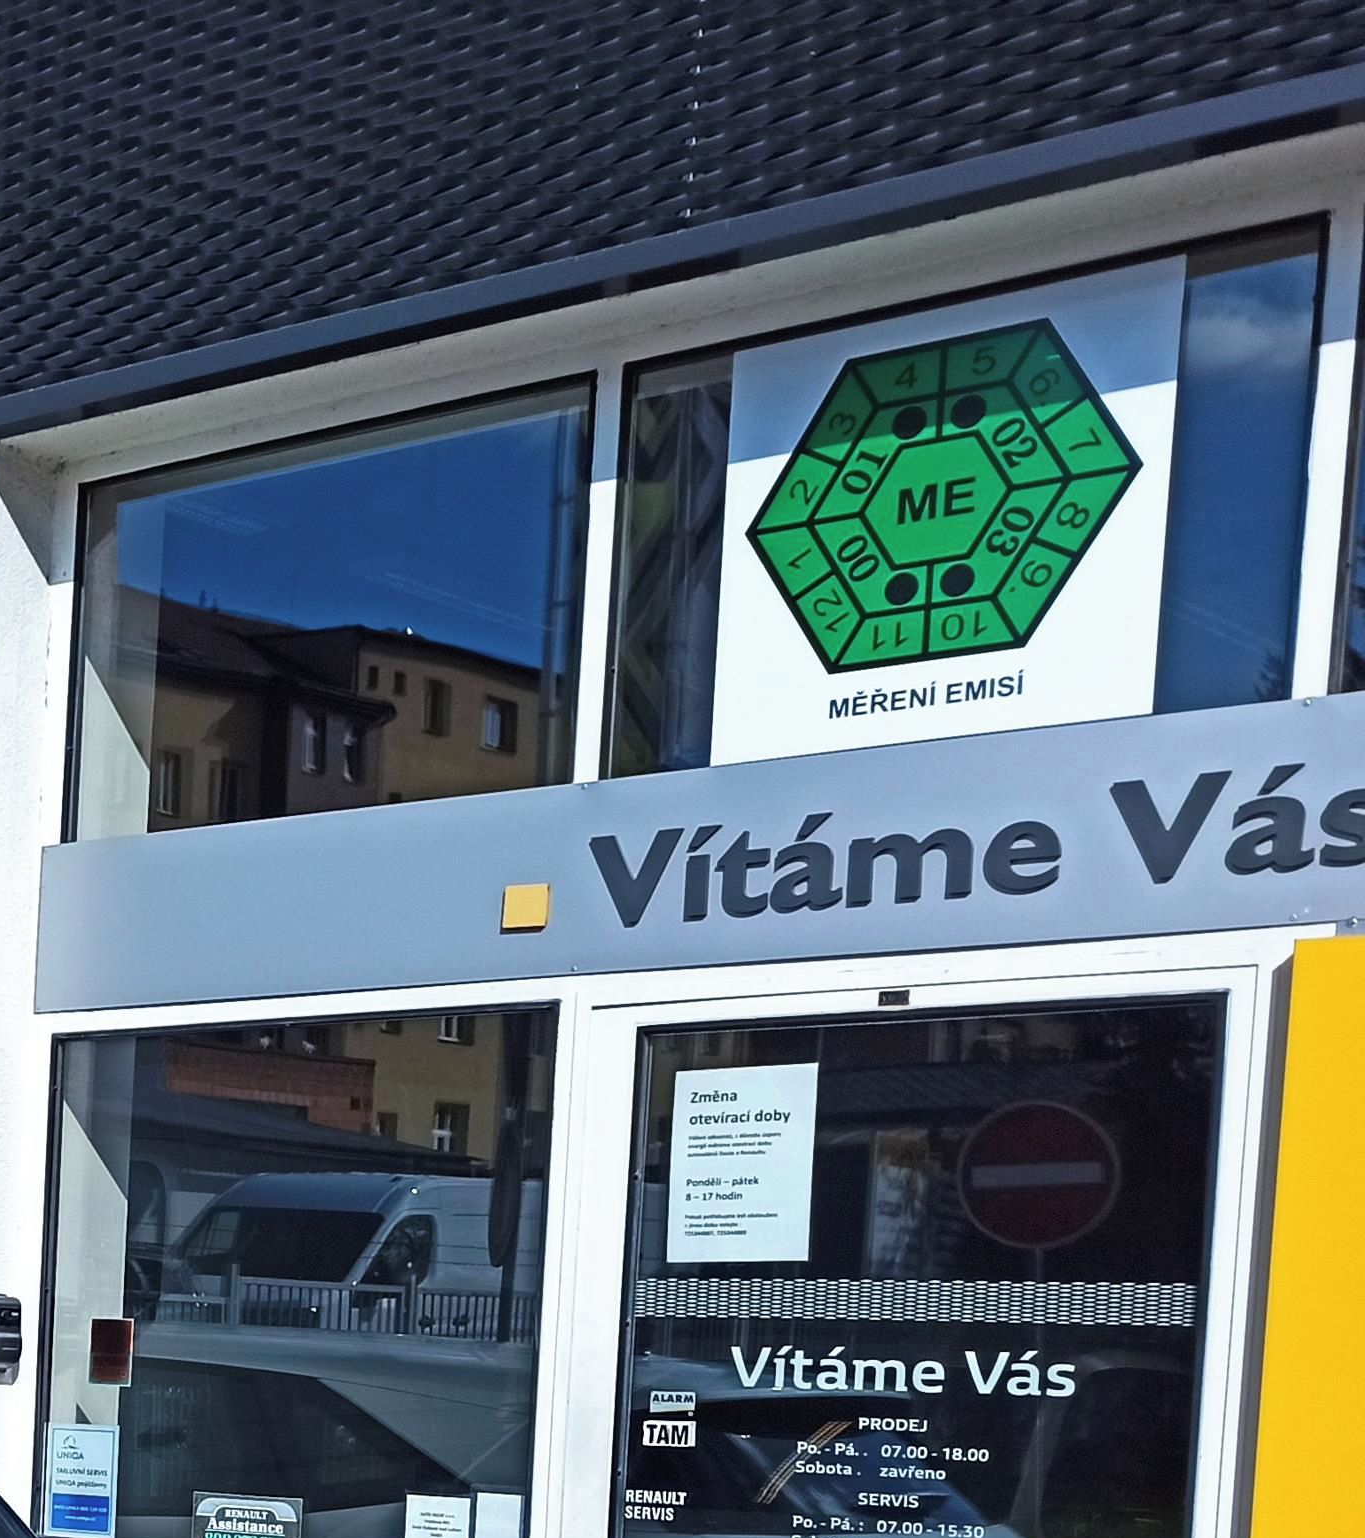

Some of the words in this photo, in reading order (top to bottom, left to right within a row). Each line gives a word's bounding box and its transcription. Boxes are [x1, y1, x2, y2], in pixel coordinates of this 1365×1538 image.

[971, 347, 997, 375] 5
[894, 364, 918, 390] 4
[829, 411, 857, 436] 3
[991, 417, 1038, 469] 02
[1068, 427, 1103, 454] 7
[790, 478, 818, 505] 2
[897, 477, 976, 525] ME
[1055, 501, 1091, 529] 8
[787, 547, 812, 570] 1
[813, 588, 849, 633] 12
[829, 681, 936, 719] MĚŘENÍ
[945, 669, 1025, 704] EMISÍ
[588, 811, 1063, 929] Vítáme
[1109, 762, 1365, 885] Vás
[690, 1090, 738, 1104] Změna
[689, 1110, 750, 1125] otevírací
[754, 1109, 791, 1123] doby
[732, 1176, 759, 1187] pátek
[685, 1193, 691, 1201] 8
[702, 1192, 713, 1201] 17
[715, 1191, 743, 1201] hodin
[731, 1345, 945, 1394] Vítáme
[964, 1350, 1077, 1398] Vás
[652, 1393, 694, 1404] ALARM
[646, 1423, 689, 1446] TAM
[858, 1417, 928, 1433] PRODEJ
[56, 1451, 84, 1460] UNIQA
[880, 1445, 928, 1460] 07.00
[943, 1447, 990, 1462] 18.00
[795, 1461, 852, 1476] Sobota
[879, 1465, 946, 1481] zavřeno
[625, 1489, 687, 1506] RENAULT
[857, 1493, 920, 1509] SERVIS
[225, 1509, 268, 1520] RENAULT
[624, 1505, 675, 1521] SERVIS
[207, 1517, 284, 1534] Assistance
[876, 1520, 923, 1535] 07.00
[938, 1524, 985, 1538] 15.30
